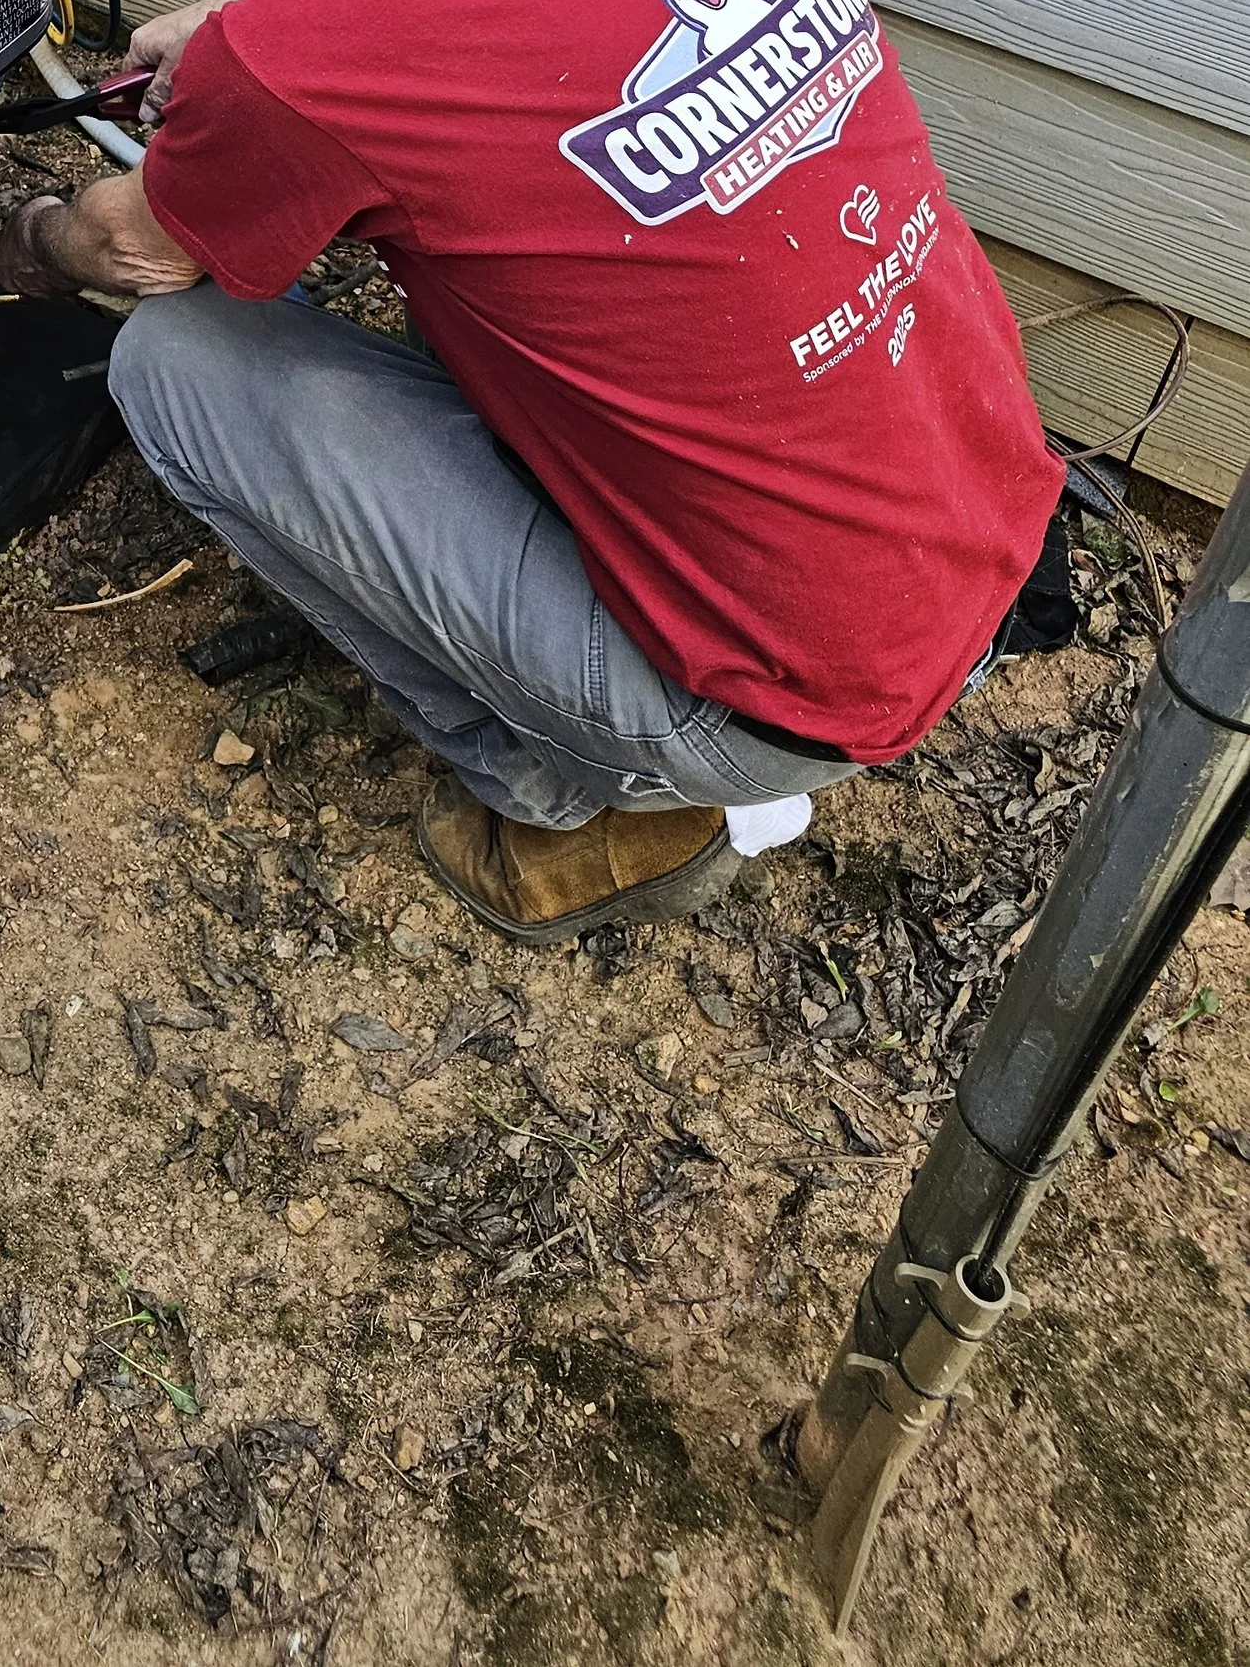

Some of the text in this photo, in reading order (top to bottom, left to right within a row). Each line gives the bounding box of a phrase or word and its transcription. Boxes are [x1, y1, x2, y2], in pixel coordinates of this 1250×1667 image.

[717, 41, 874, 197] HEATING & AIR
[789, 194, 937, 367] FEEL THE LOVE
[803, 342, 854, 383] Sponsored
[854, 332, 866, 346] by
[865, 313, 882, 335] THE
[886, 272, 917, 306] LENNOX
[888, 303, 916, 367] 2025
